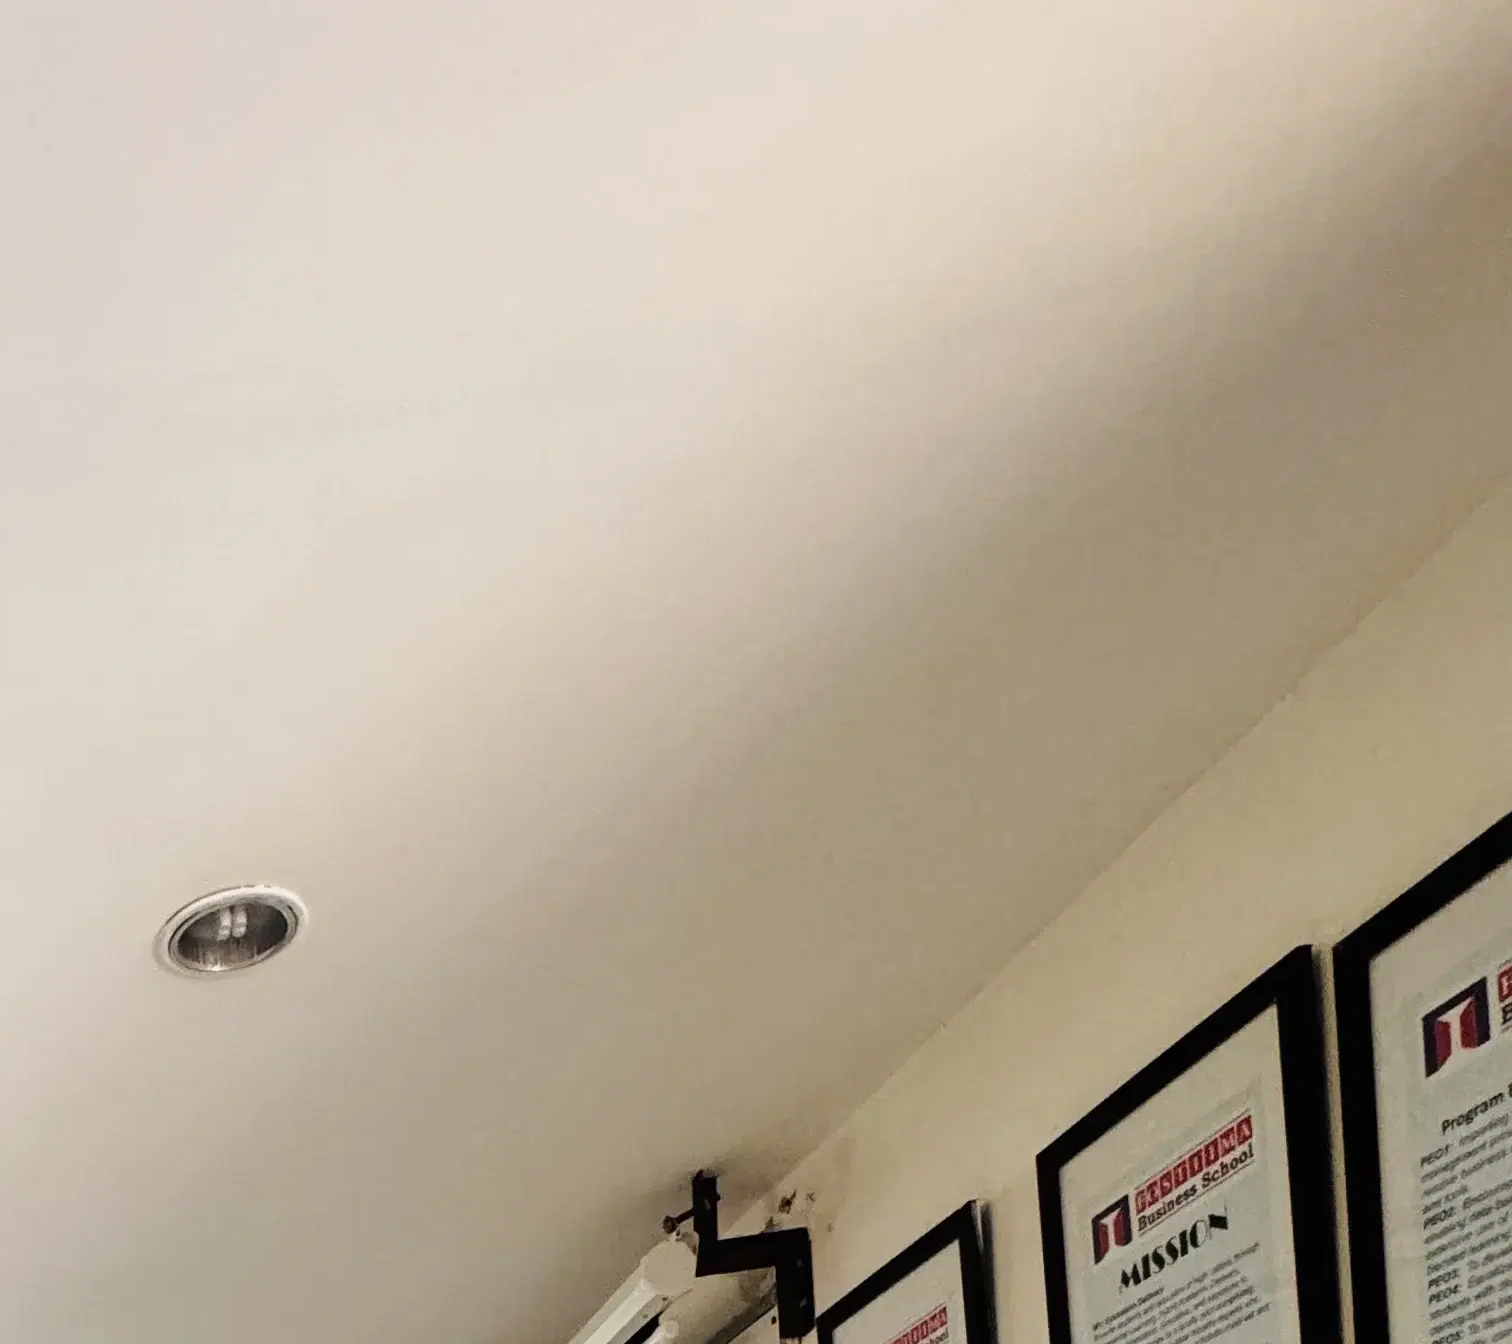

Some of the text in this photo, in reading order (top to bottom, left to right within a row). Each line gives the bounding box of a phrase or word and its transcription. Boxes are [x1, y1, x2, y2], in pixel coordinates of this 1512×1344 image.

[1441, 1090, 1505, 1136] Program
[1137, 1142, 1255, 1232] Business School
[1118, 1213, 1229, 1297] MISSION
